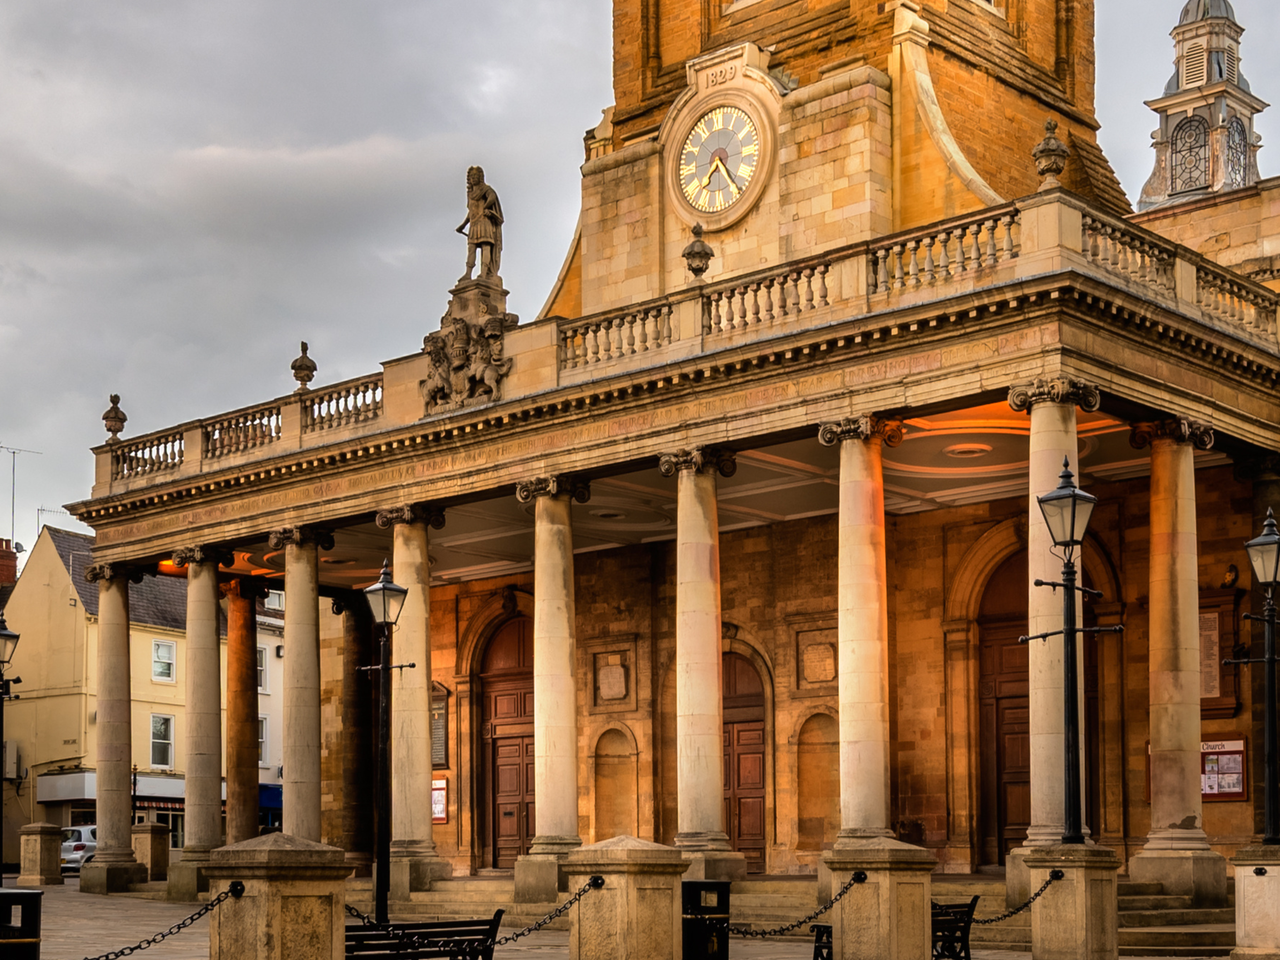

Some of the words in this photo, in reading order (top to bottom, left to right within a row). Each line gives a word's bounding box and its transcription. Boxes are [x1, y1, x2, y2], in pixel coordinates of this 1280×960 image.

[705, 64, 737, 89] 1829
[742, 144, 756, 157] III
[313, 483, 333, 497] GAVE
[347, 473, 384, 488] THOUSAND
[420, 460, 449, 473] TIMBER
[496, 445, 513, 456] THE
[517, 434, 568, 452] REBUILDING
[610, 414, 650, 430] CHURCH
[676, 406, 690, 416] TO
[1202, 742, 1226, 750] Church
